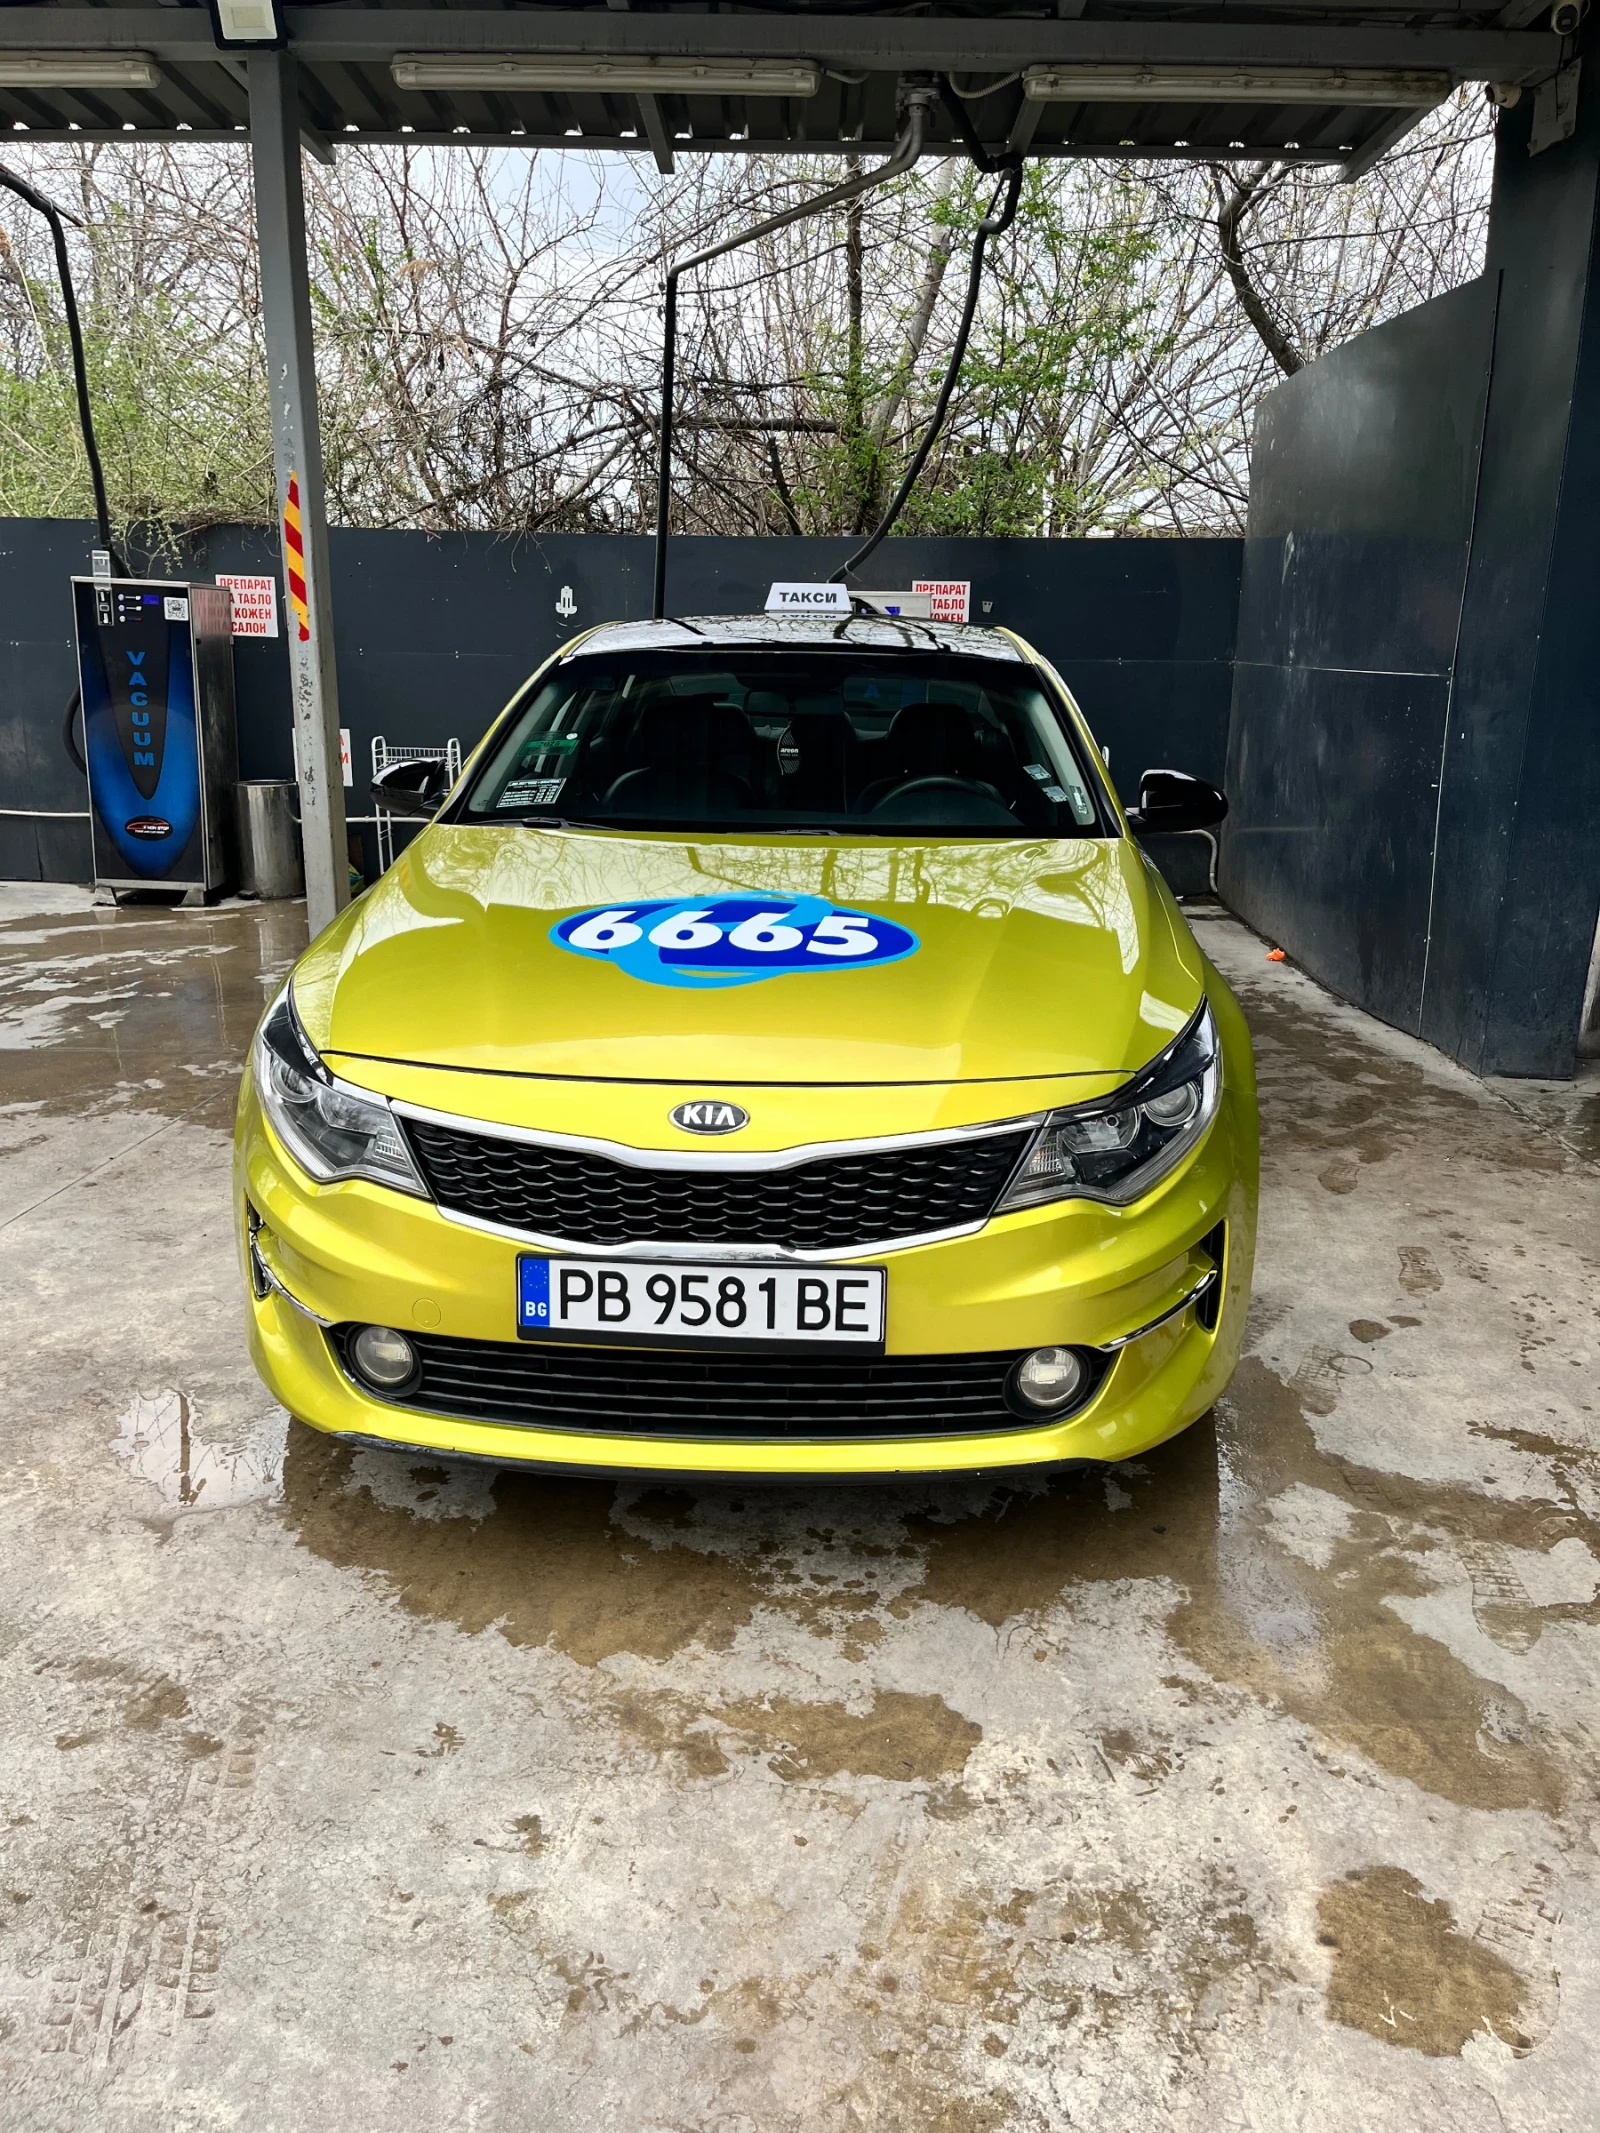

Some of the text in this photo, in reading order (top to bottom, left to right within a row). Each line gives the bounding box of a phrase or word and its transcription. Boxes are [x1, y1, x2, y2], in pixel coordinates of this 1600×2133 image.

[219, 578, 272, 590] ПРЕПАРАТ
[915, 584, 967, 595] ПРЕПАРАТ
[238, 593, 272, 605] ТАБЛО
[779, 592, 837, 604] ТАКСИ
[932, 598, 965, 610] ТАБЛО
[234, 607, 272, 619] КОЖЕН
[231, 621, 266, 633] САЛОН
[126, 651, 155, 766] VACUUM
[568, 910, 879, 957] 6665
[683, 1104, 735, 1126] KIA
[559, 1268, 870, 1332] PB 9581 BE
[525, 1301, 547, 1317] BG
